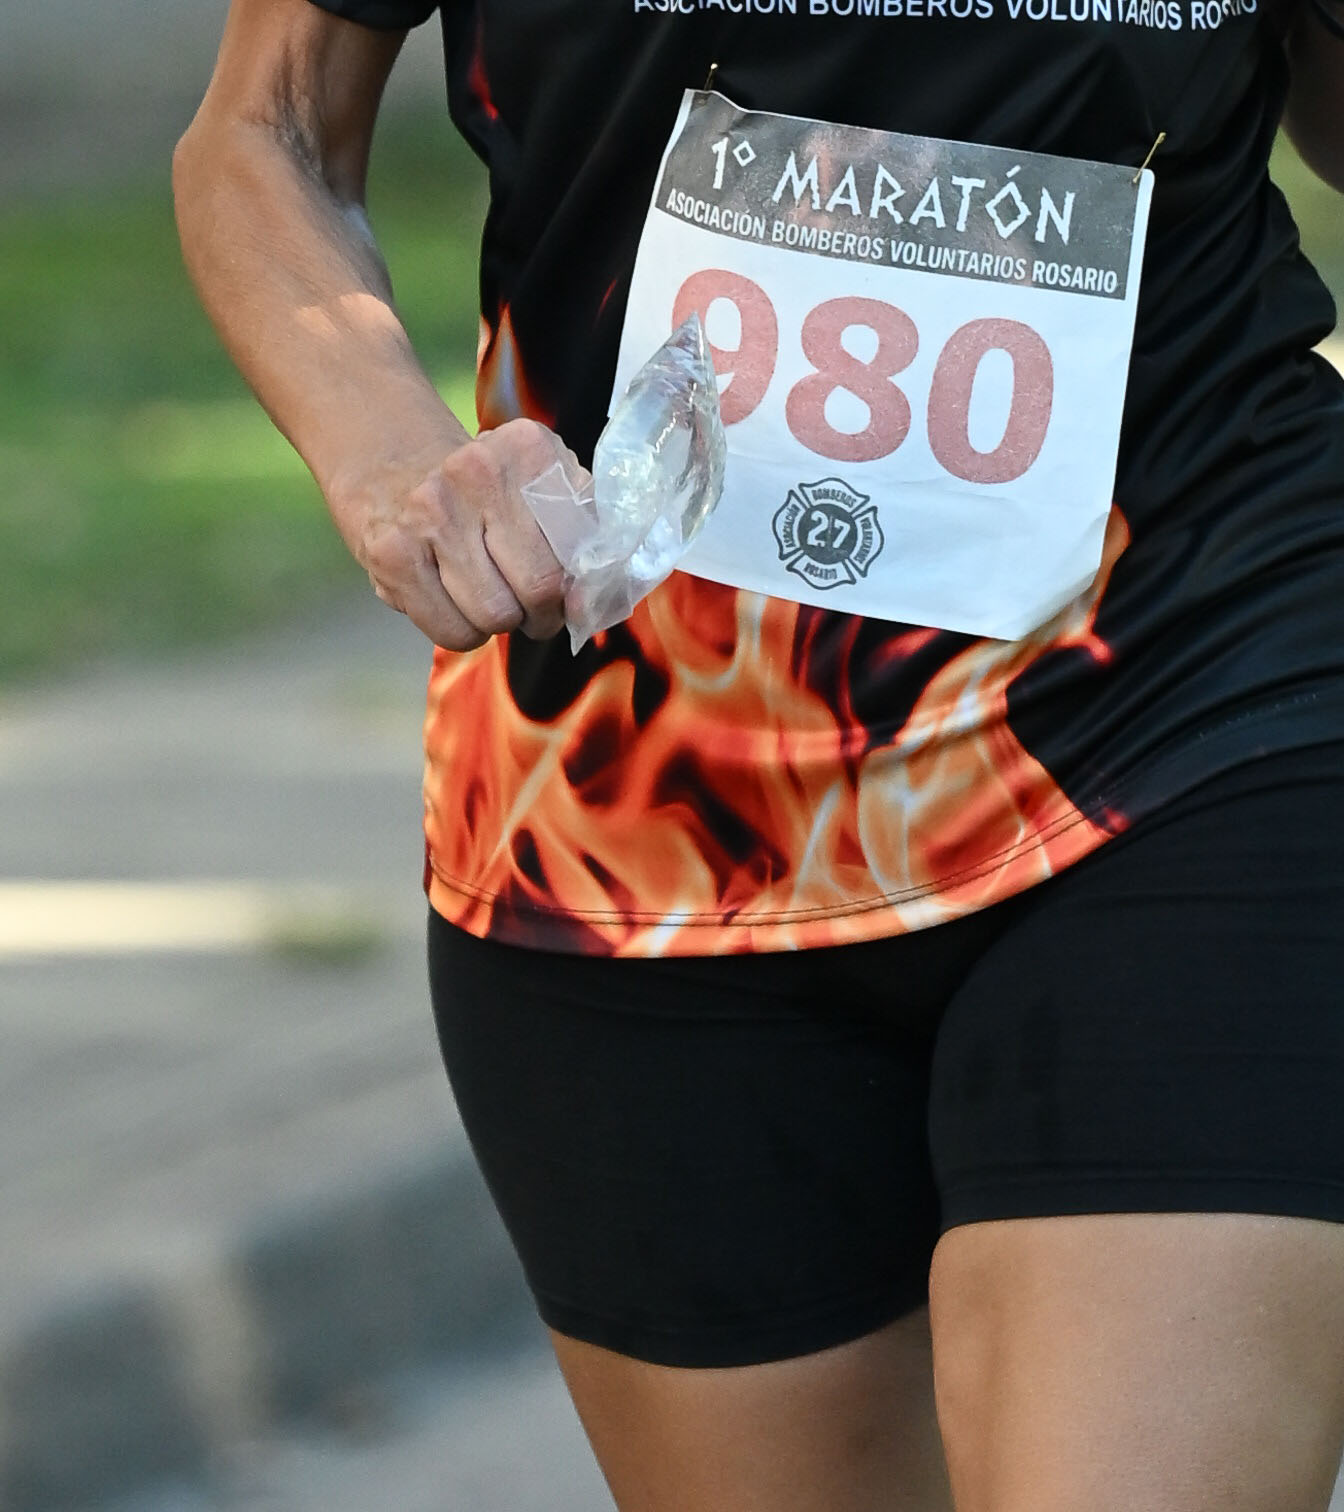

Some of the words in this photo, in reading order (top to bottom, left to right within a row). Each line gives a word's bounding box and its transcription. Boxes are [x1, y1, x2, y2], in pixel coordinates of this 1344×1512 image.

[665, 187, 767, 239] ASOCIACIÓN
[771, 220, 885, 261] BOMBEROS
[889, 240, 1028, 281] VOLUNTARIOS
[1031, 259, 1118, 294] ROSARIO
[771, 150, 1077, 246] MARATÓN
[670, 268, 1055, 486] 980
[806, 509, 852, 549] 27
